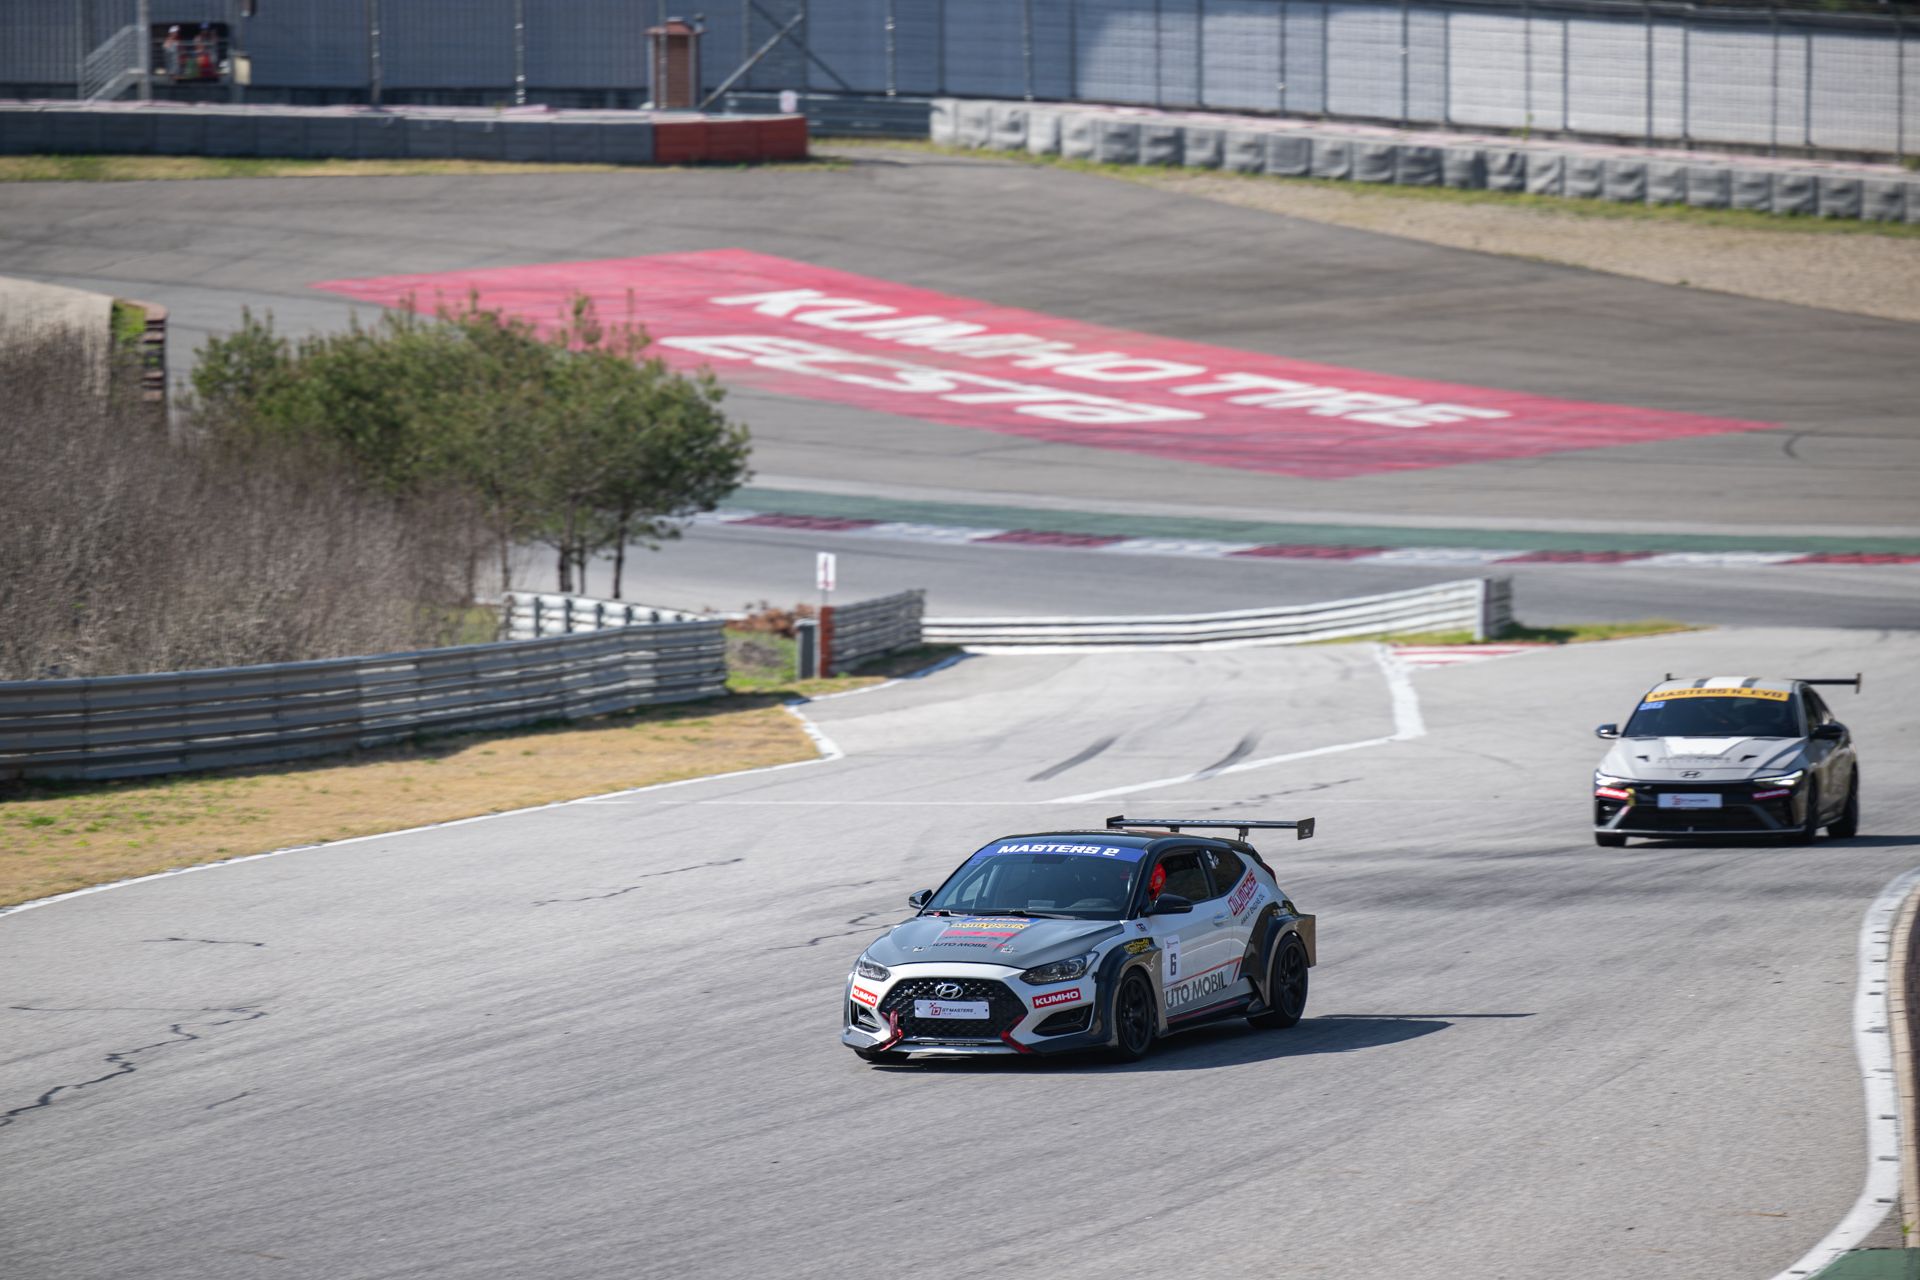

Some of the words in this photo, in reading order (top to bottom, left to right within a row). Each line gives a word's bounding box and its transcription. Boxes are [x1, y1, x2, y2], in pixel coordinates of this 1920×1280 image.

[706, 288, 1208, 383] KUMHO
[1170, 372, 1513, 428] TIRE
[1652, 687, 1727, 699] MASTERS
[997, 844, 1100, 855] MASTERS
[1102, 848, 1121, 857] 2
[1170, 953, 1177, 976] 6
[853, 988, 877, 1005] KUMHO
[1035, 990, 1079, 1006] KUMHO
[1163, 984, 1190, 1009] UTO
[1192, 971, 1228, 1000] MOBIL
